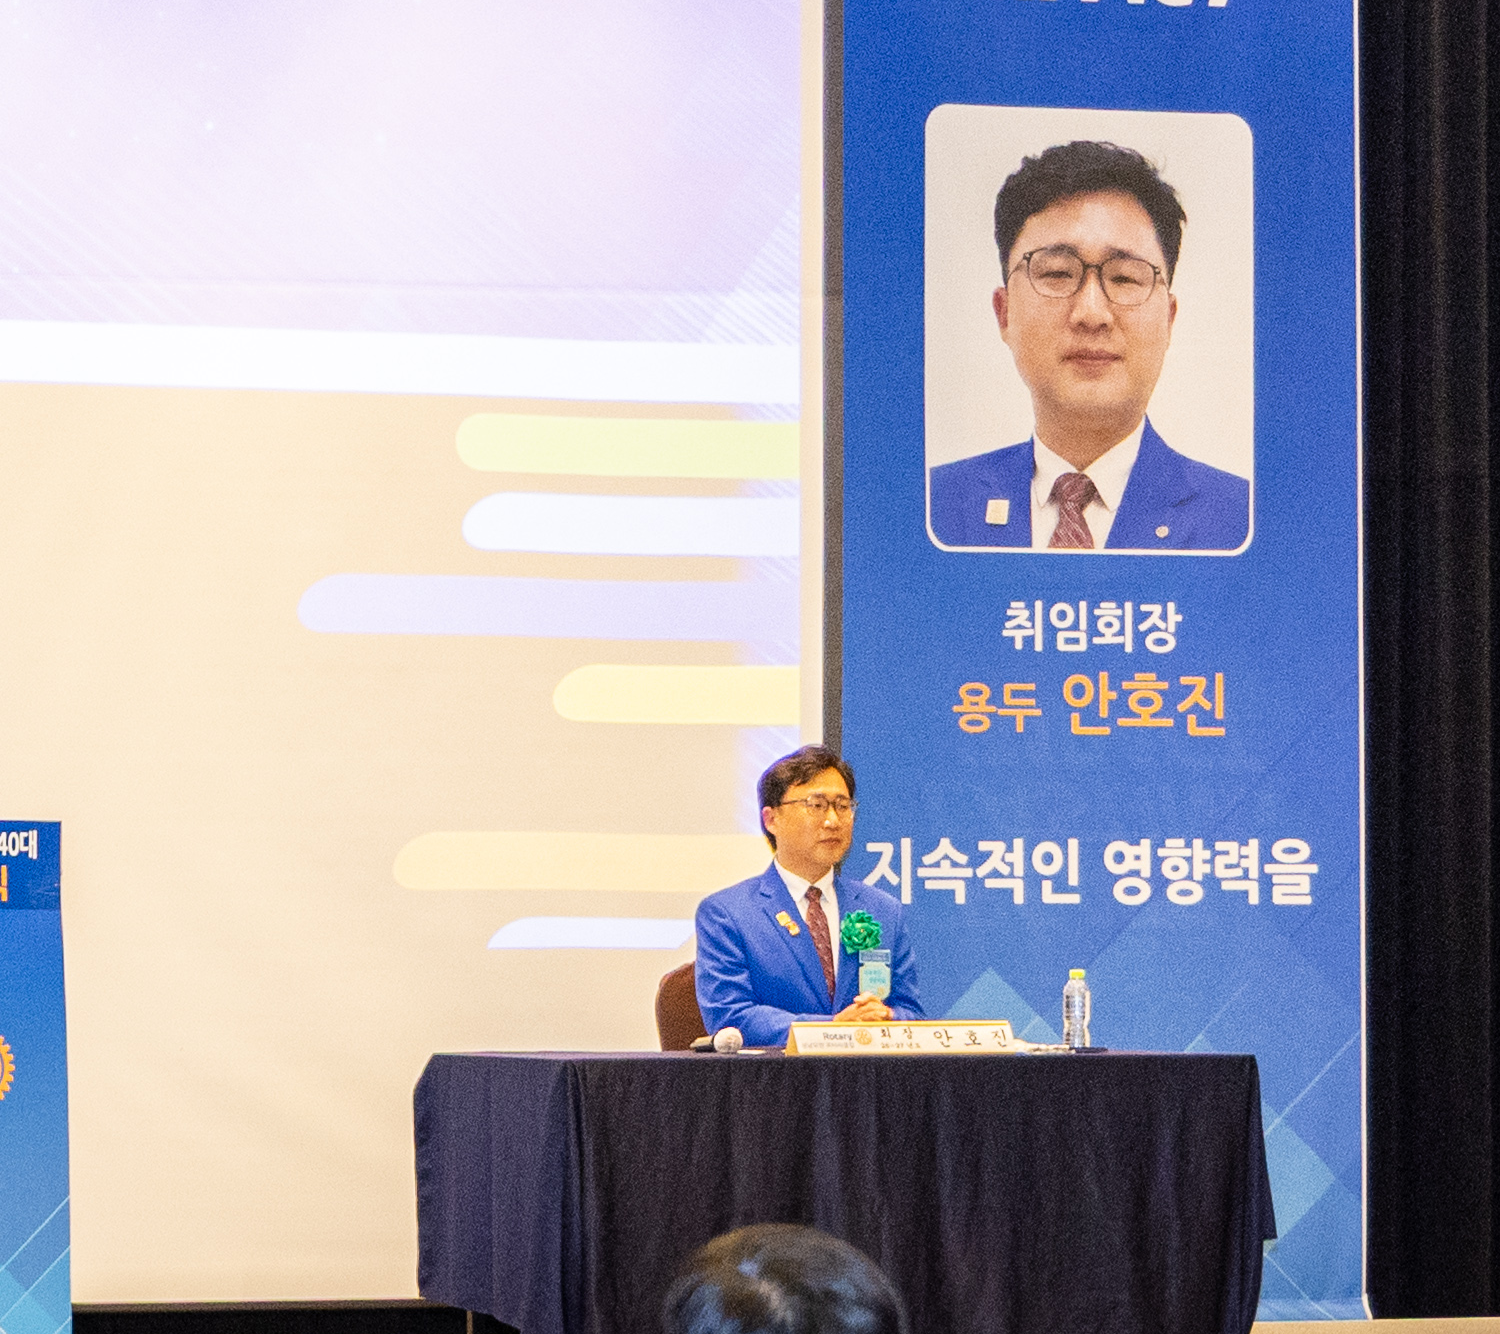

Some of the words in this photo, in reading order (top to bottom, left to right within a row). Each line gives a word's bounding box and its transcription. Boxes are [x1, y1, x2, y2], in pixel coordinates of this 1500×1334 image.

[1002, 600, 1182, 653] 취임회장
[953, 682, 1042, 733] 용두
[1063, 672, 1225, 736] 안호진
[863, 838, 1080, 904] 지속적인
[1104, 839, 1318, 905] 영향력을
[823, 1032, 852, 1042] Rotary
